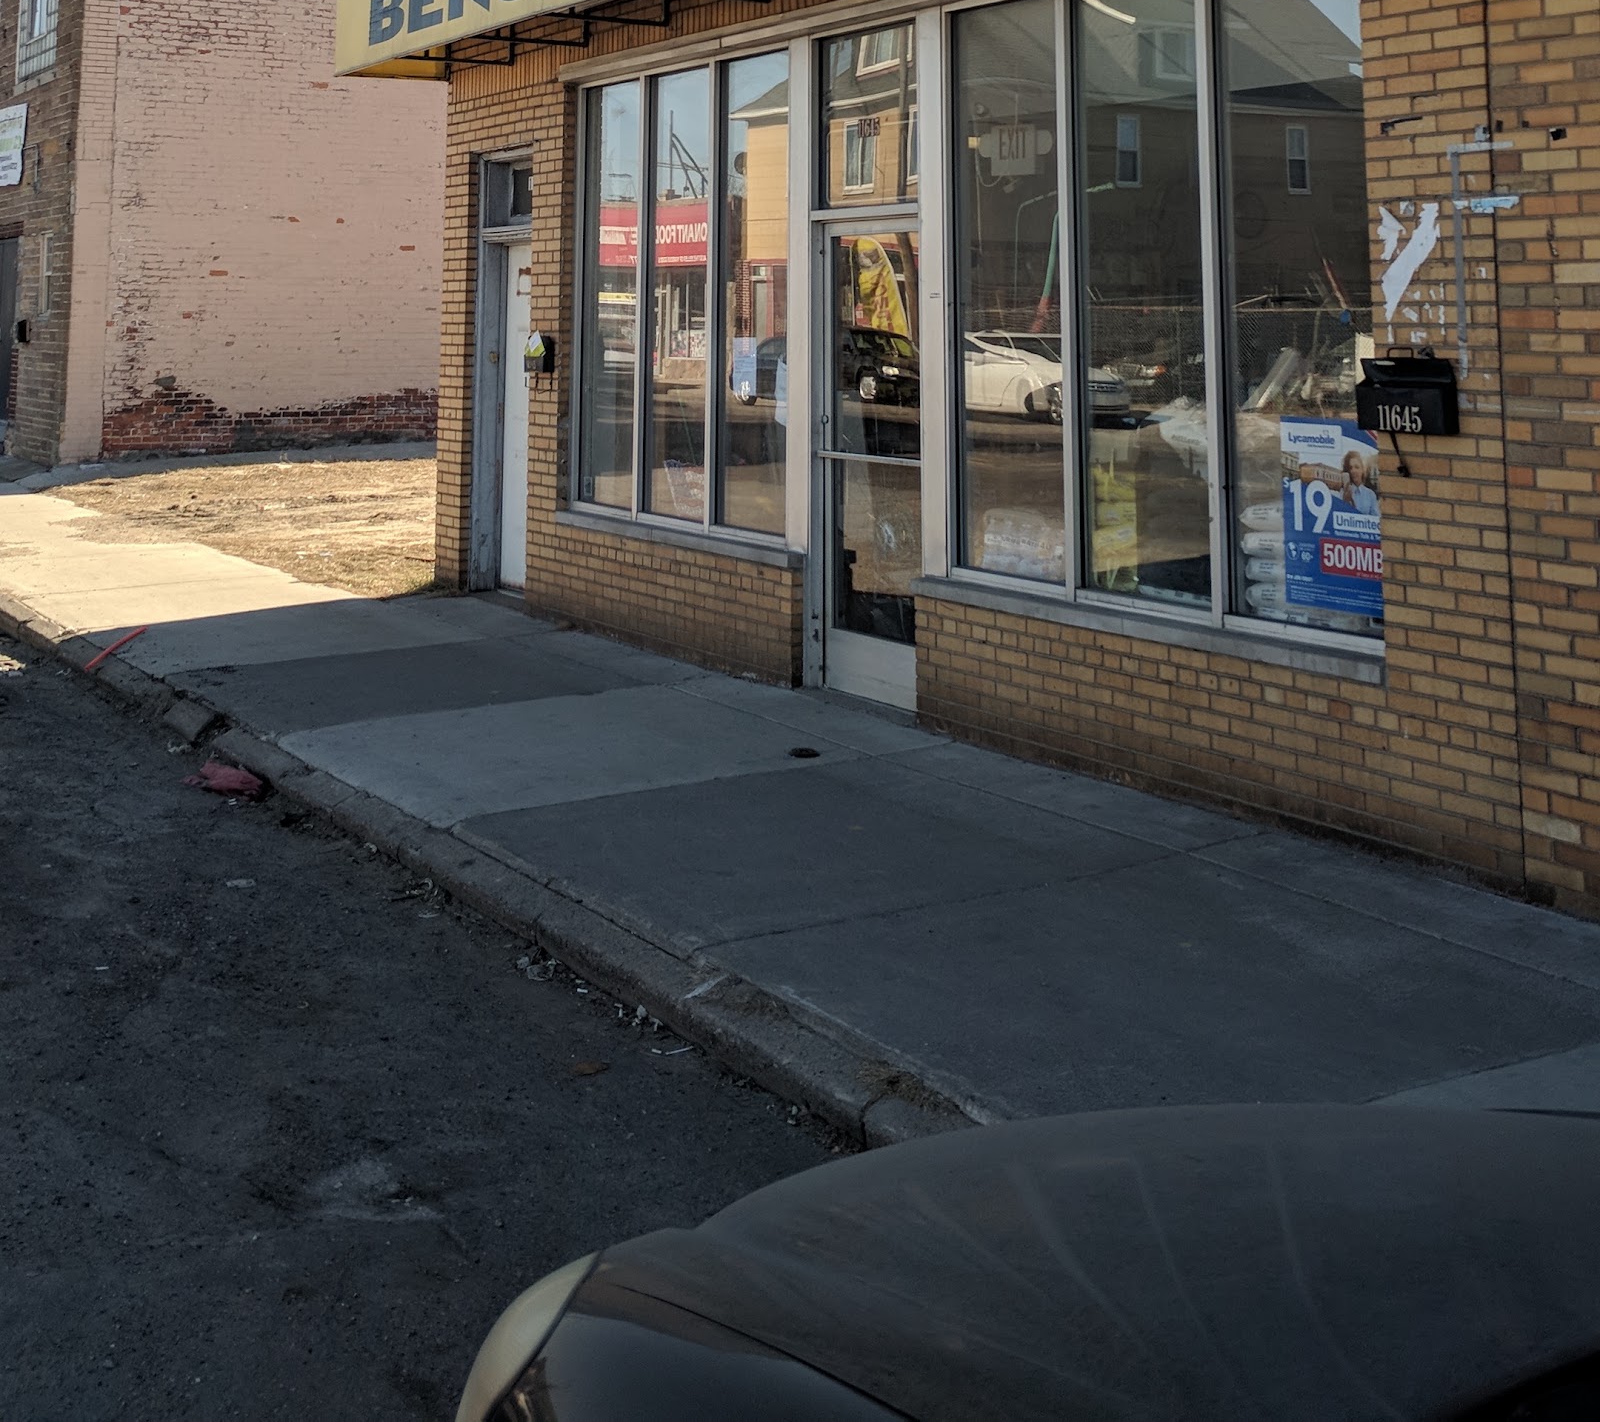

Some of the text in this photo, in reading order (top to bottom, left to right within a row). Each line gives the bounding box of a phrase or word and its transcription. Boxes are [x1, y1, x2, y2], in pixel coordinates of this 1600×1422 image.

[999, 127, 1029, 160] EXIT
[1376, 404, 1422, 433] 11645
[1288, 431, 1335, 445] Lycamobile
[1323, 542, 1383, 573] 500MB
